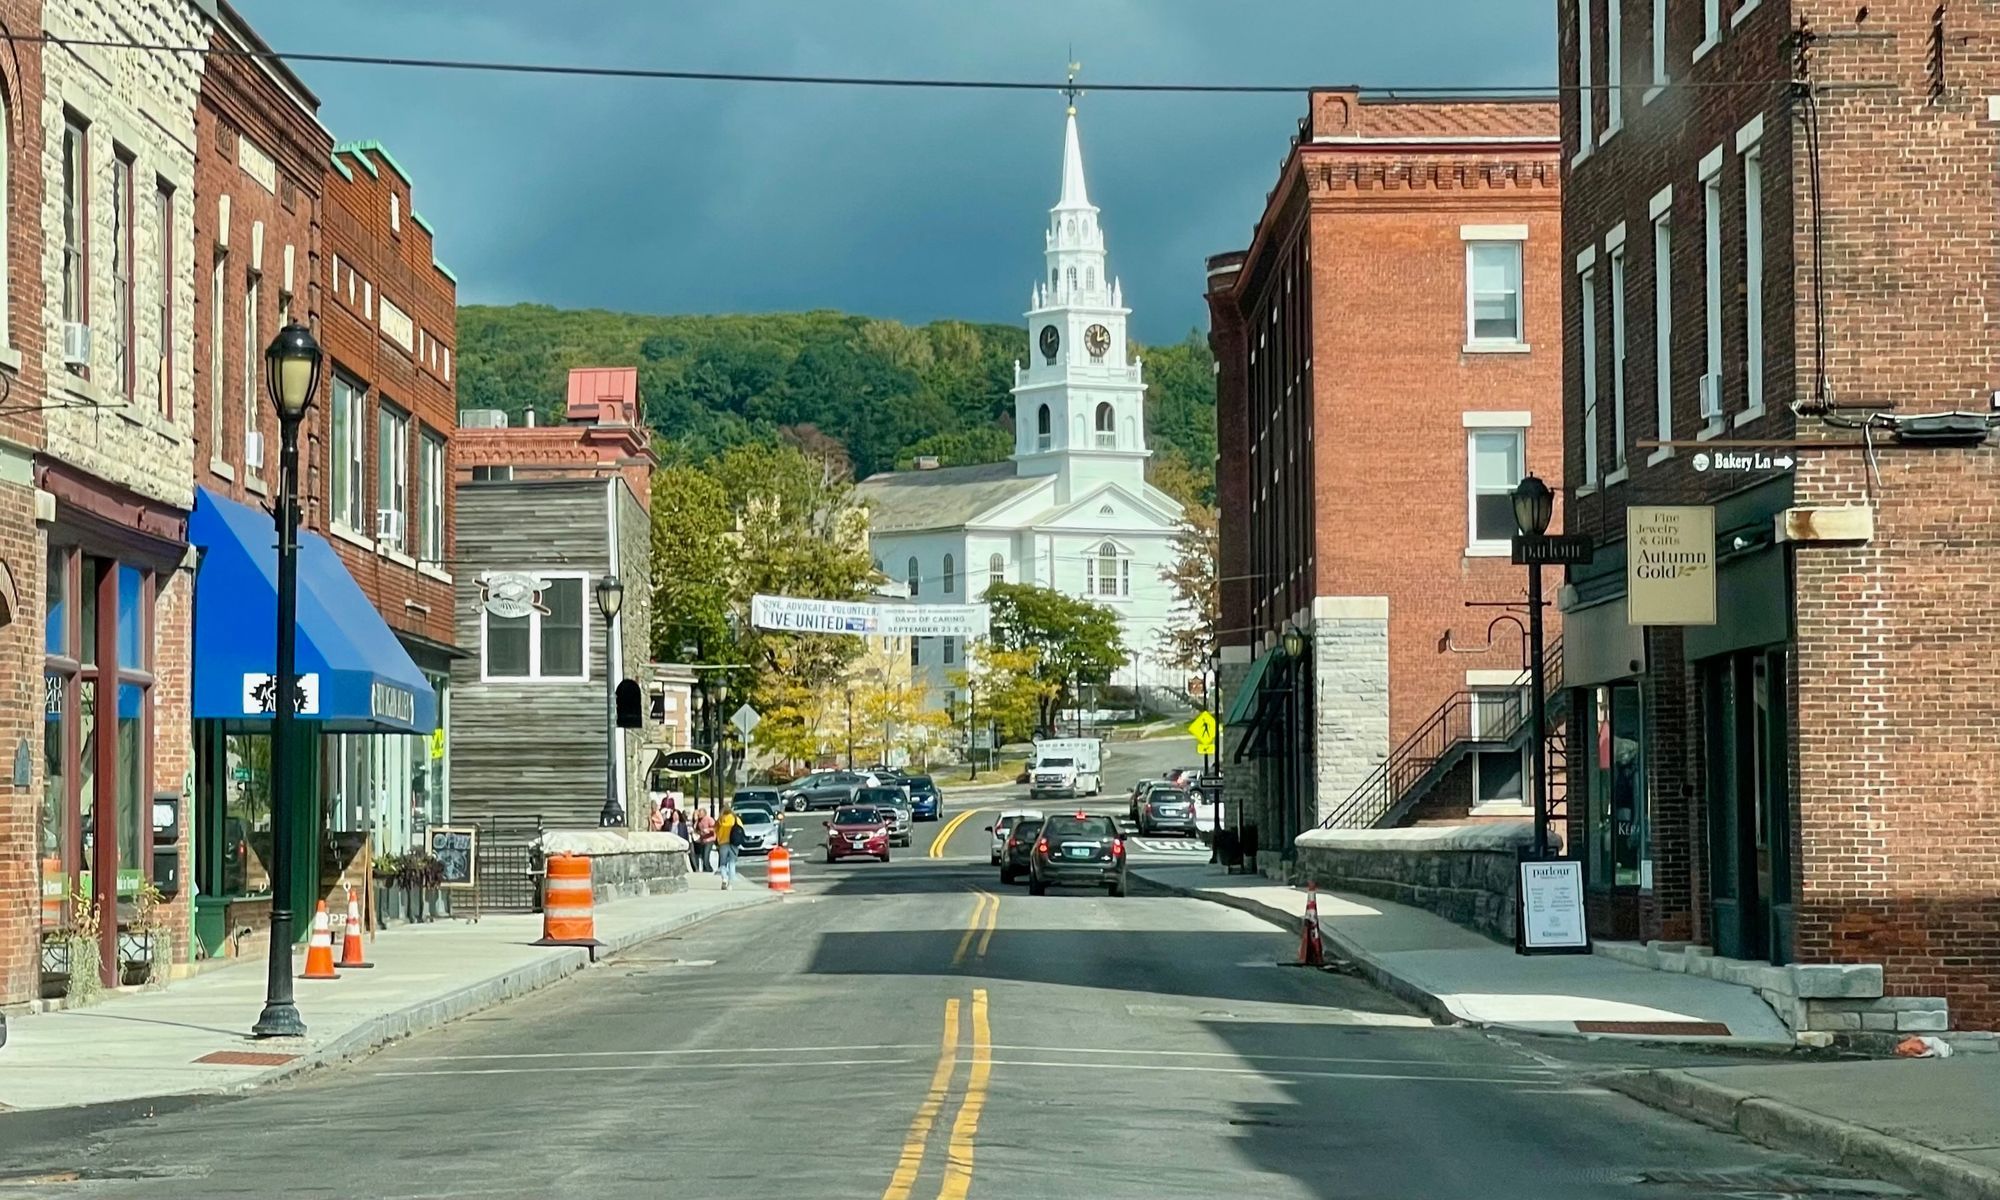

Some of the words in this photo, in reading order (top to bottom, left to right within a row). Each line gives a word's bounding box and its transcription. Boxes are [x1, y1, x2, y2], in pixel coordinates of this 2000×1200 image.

[1714, 453, 1753, 472] Bakery
[1755, 453, 1771, 469] Ln
[1654, 513, 1680, 523] Fine
[1636, 524, 1678, 535] Jewelry
[1652, 536, 1680, 545] Gifts
[1522, 538, 1580, 563] parlour
[1638, 549, 1706, 564] Autumn
[1637, 565, 1676, 579] Gold
[763, 610, 791, 627] LIVE
[796, 614, 843, 630] UNITED
[1533, 866, 1570, 878] parlour
